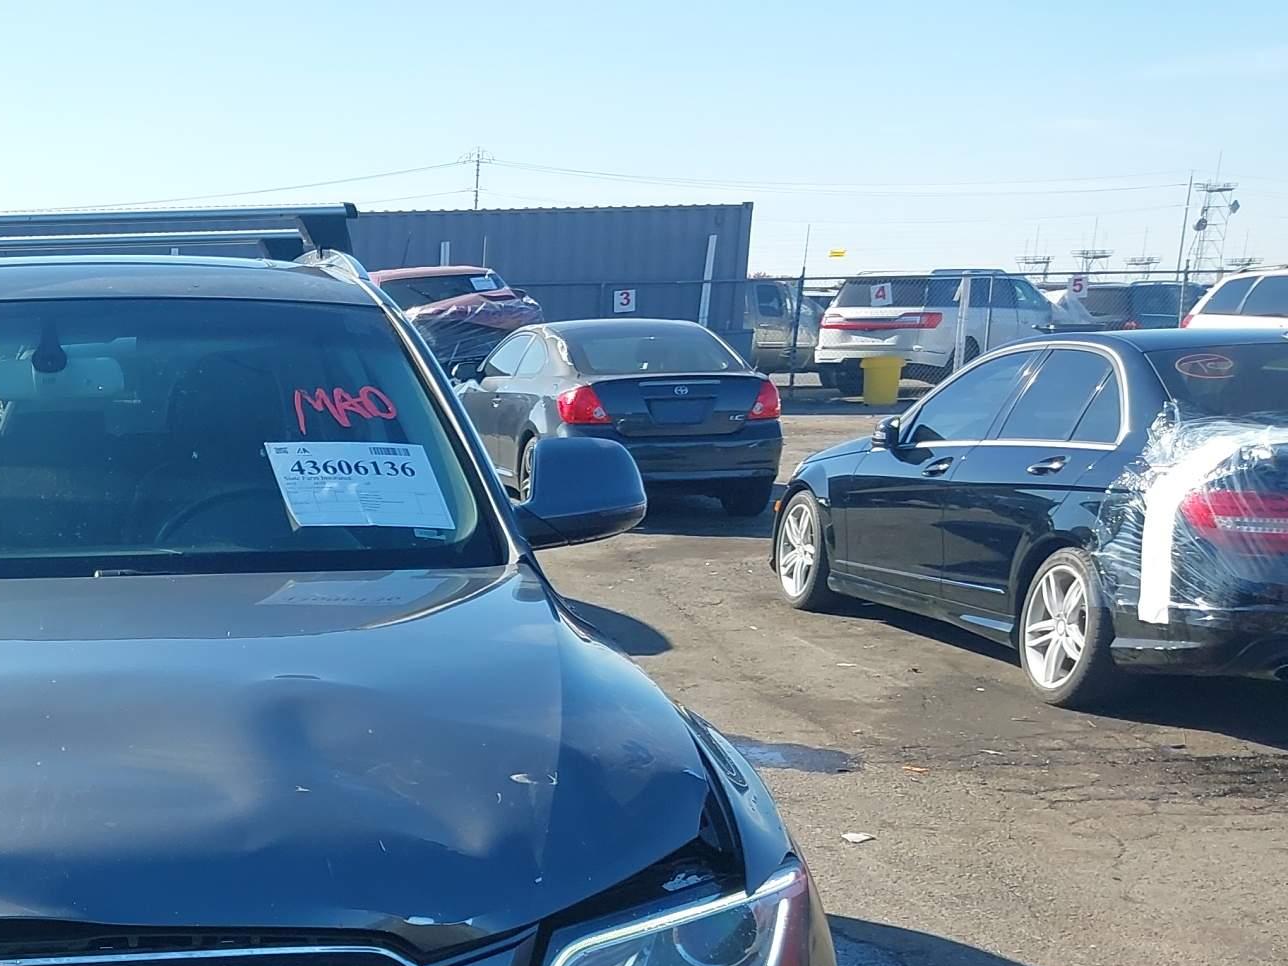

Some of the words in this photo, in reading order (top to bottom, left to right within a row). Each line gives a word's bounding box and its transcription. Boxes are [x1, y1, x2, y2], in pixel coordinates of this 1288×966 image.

[874, 285, 887, 300] 4
[1072, 278, 1084, 293] 5
[619, 291, 631, 307] 3
[290, 459, 416, 478] 43606136
